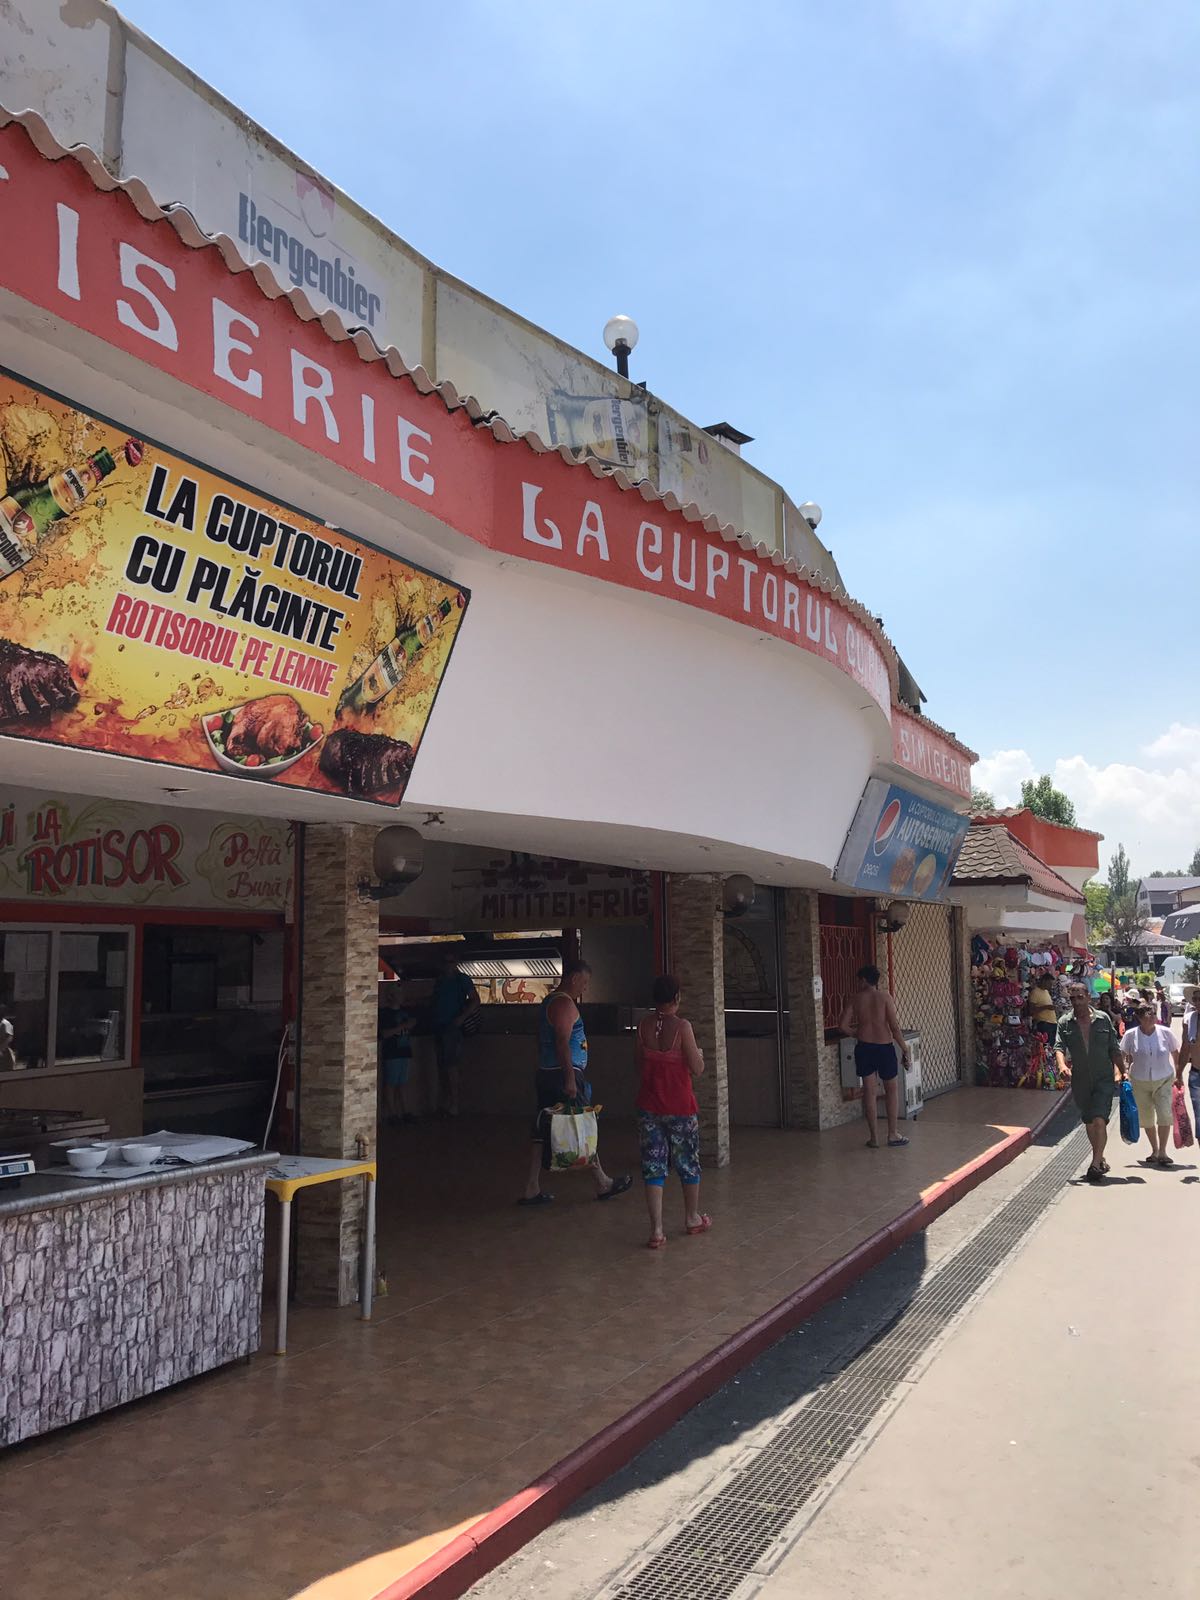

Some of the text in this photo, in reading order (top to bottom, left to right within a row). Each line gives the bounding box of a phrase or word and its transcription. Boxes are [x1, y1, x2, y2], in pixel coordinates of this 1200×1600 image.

[239, 192, 381, 329] Bergenbier
[0, 164, 435, 496] ISERIE
[126, 534, 345, 653] CU PLĂCINTE
[144, 464, 363, 600] LA CUPTORUL
[521, 481, 610, 562] LA
[636, 520, 838, 655] CUPTORUL
[106, 593, 338, 698] ROTISORUL PE LEMNE
[900, 728, 970, 793] SIMIGERIE
[33, 807, 63, 846] LA
